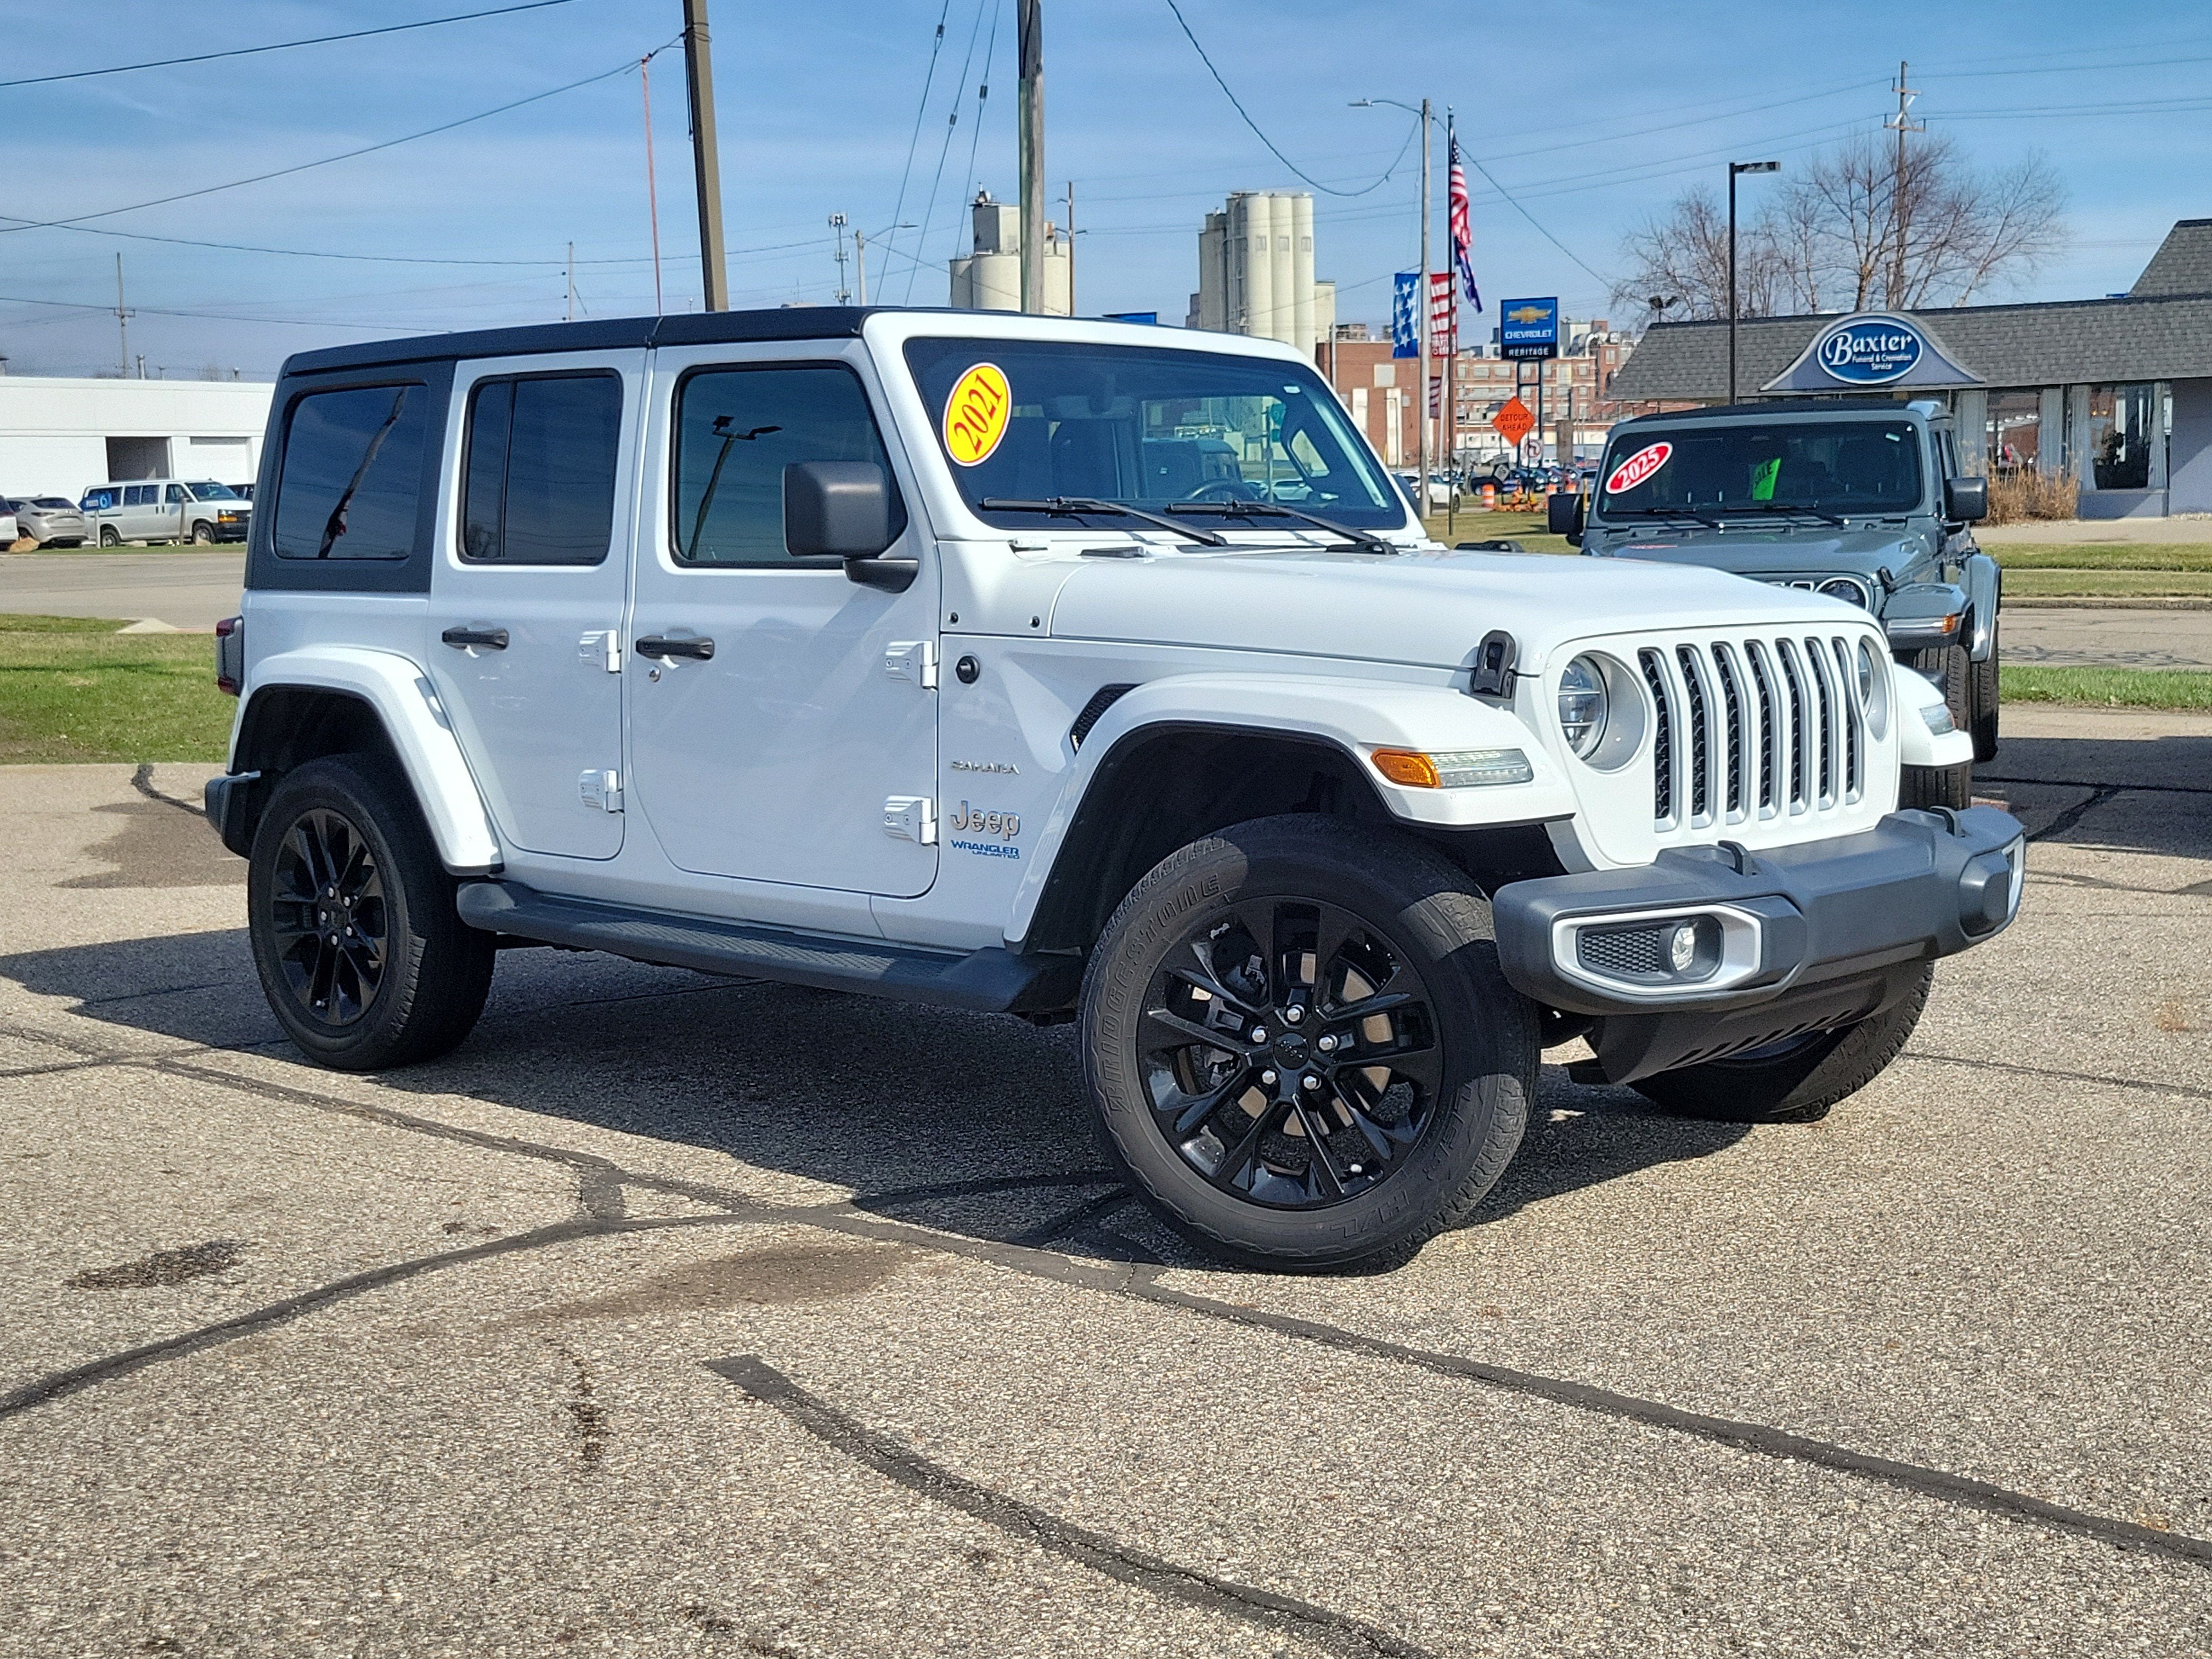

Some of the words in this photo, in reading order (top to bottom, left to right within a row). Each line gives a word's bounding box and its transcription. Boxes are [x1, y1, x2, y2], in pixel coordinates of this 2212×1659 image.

[1505, 330, 1553, 339] CHEVROLET
[1509, 346, 1549, 356] HERITAGE
[1825, 331, 1912, 365] Baxter
[953, 373, 1003, 455] 2021
[1500, 414, 1528, 422] DETOUR
[1617, 448, 1660, 489] 2025
[951, 760, 1020, 775] SAHARA
[950, 800, 1020, 842] Jeep
[951, 839, 1020, 855] WRANGLER
[972, 850, 1020, 860] UNLIMITED
[1102, 873, 1222, 1114] BRIDGESTONE
